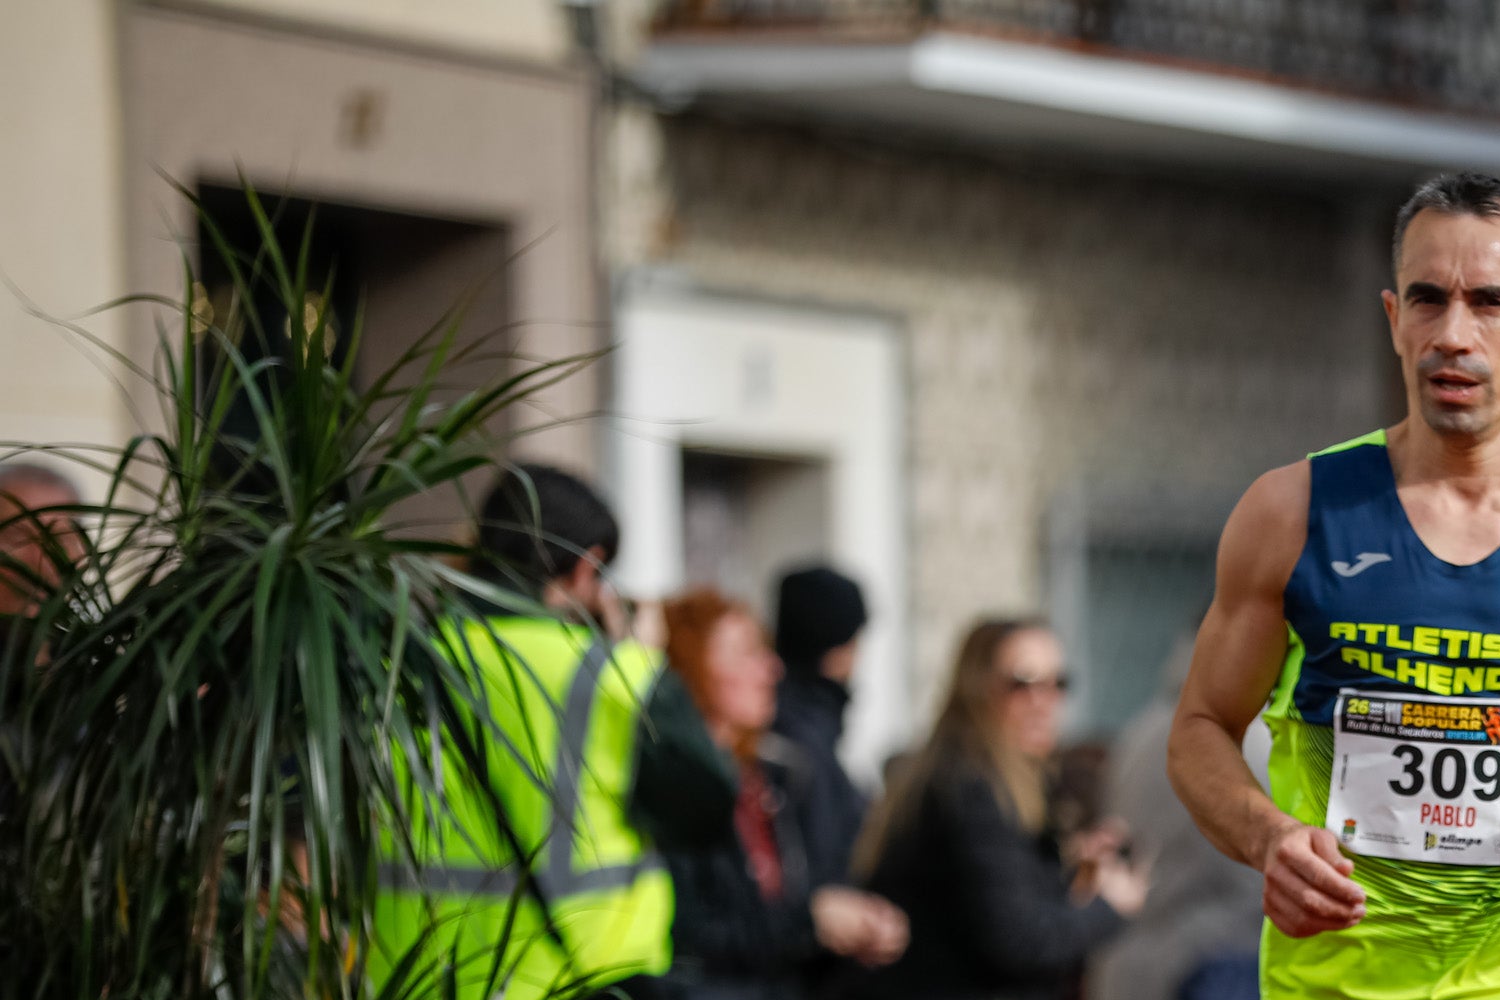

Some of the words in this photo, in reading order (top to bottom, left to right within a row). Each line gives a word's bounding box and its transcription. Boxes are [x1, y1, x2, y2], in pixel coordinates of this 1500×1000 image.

[1347, 698, 1370, 714] 26
[1402, 703, 1482, 720] CARRERA
[1369, 721, 1381, 732] de
[1402, 716, 1482, 730] POPULAR
[1421, 803, 1477, 828] PABLO
